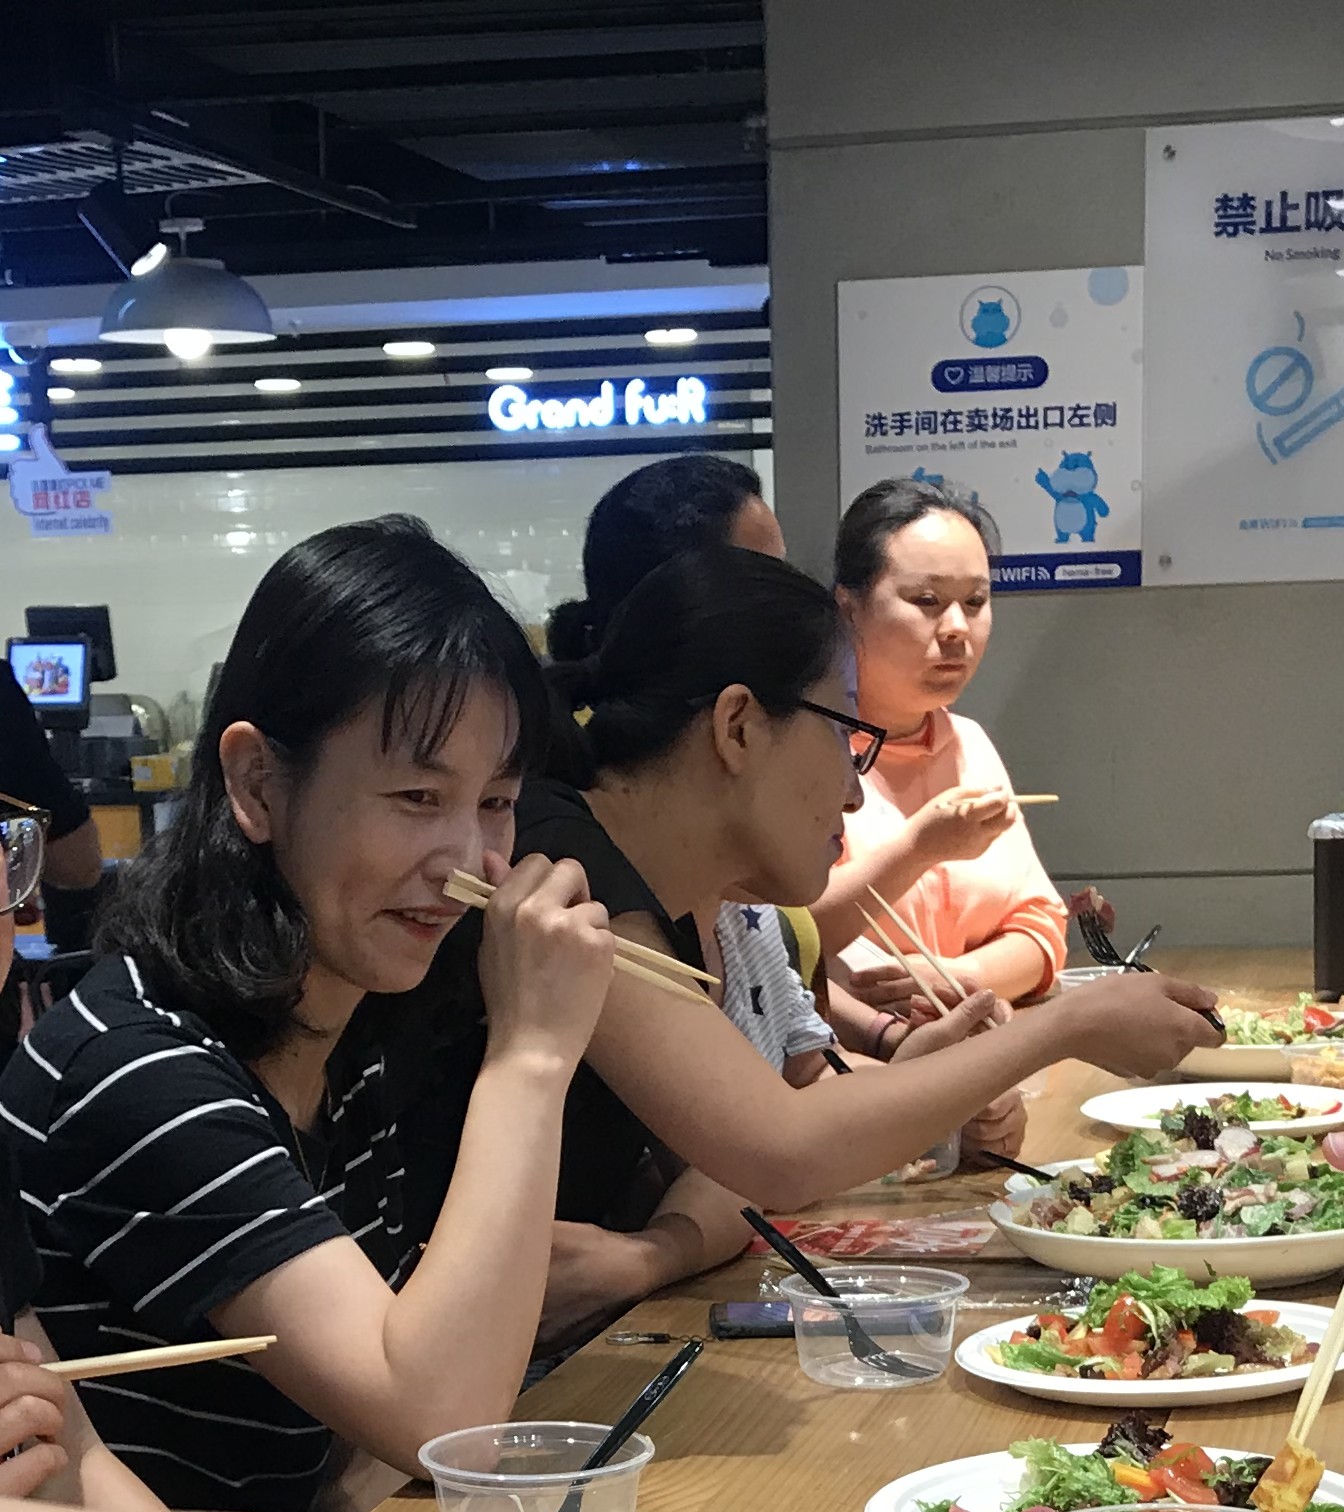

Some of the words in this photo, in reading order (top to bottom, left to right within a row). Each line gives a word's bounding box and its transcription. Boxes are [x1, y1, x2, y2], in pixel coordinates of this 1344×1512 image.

[1264, 250, 1284, 261] No
[1285, 246, 1341, 261] Smoking
[968, 363, 1035, 384] 温馨提示
[488, 379, 614, 432] Grand
[864, 402, 1118, 438] 洗手间在卖场出口左侧
